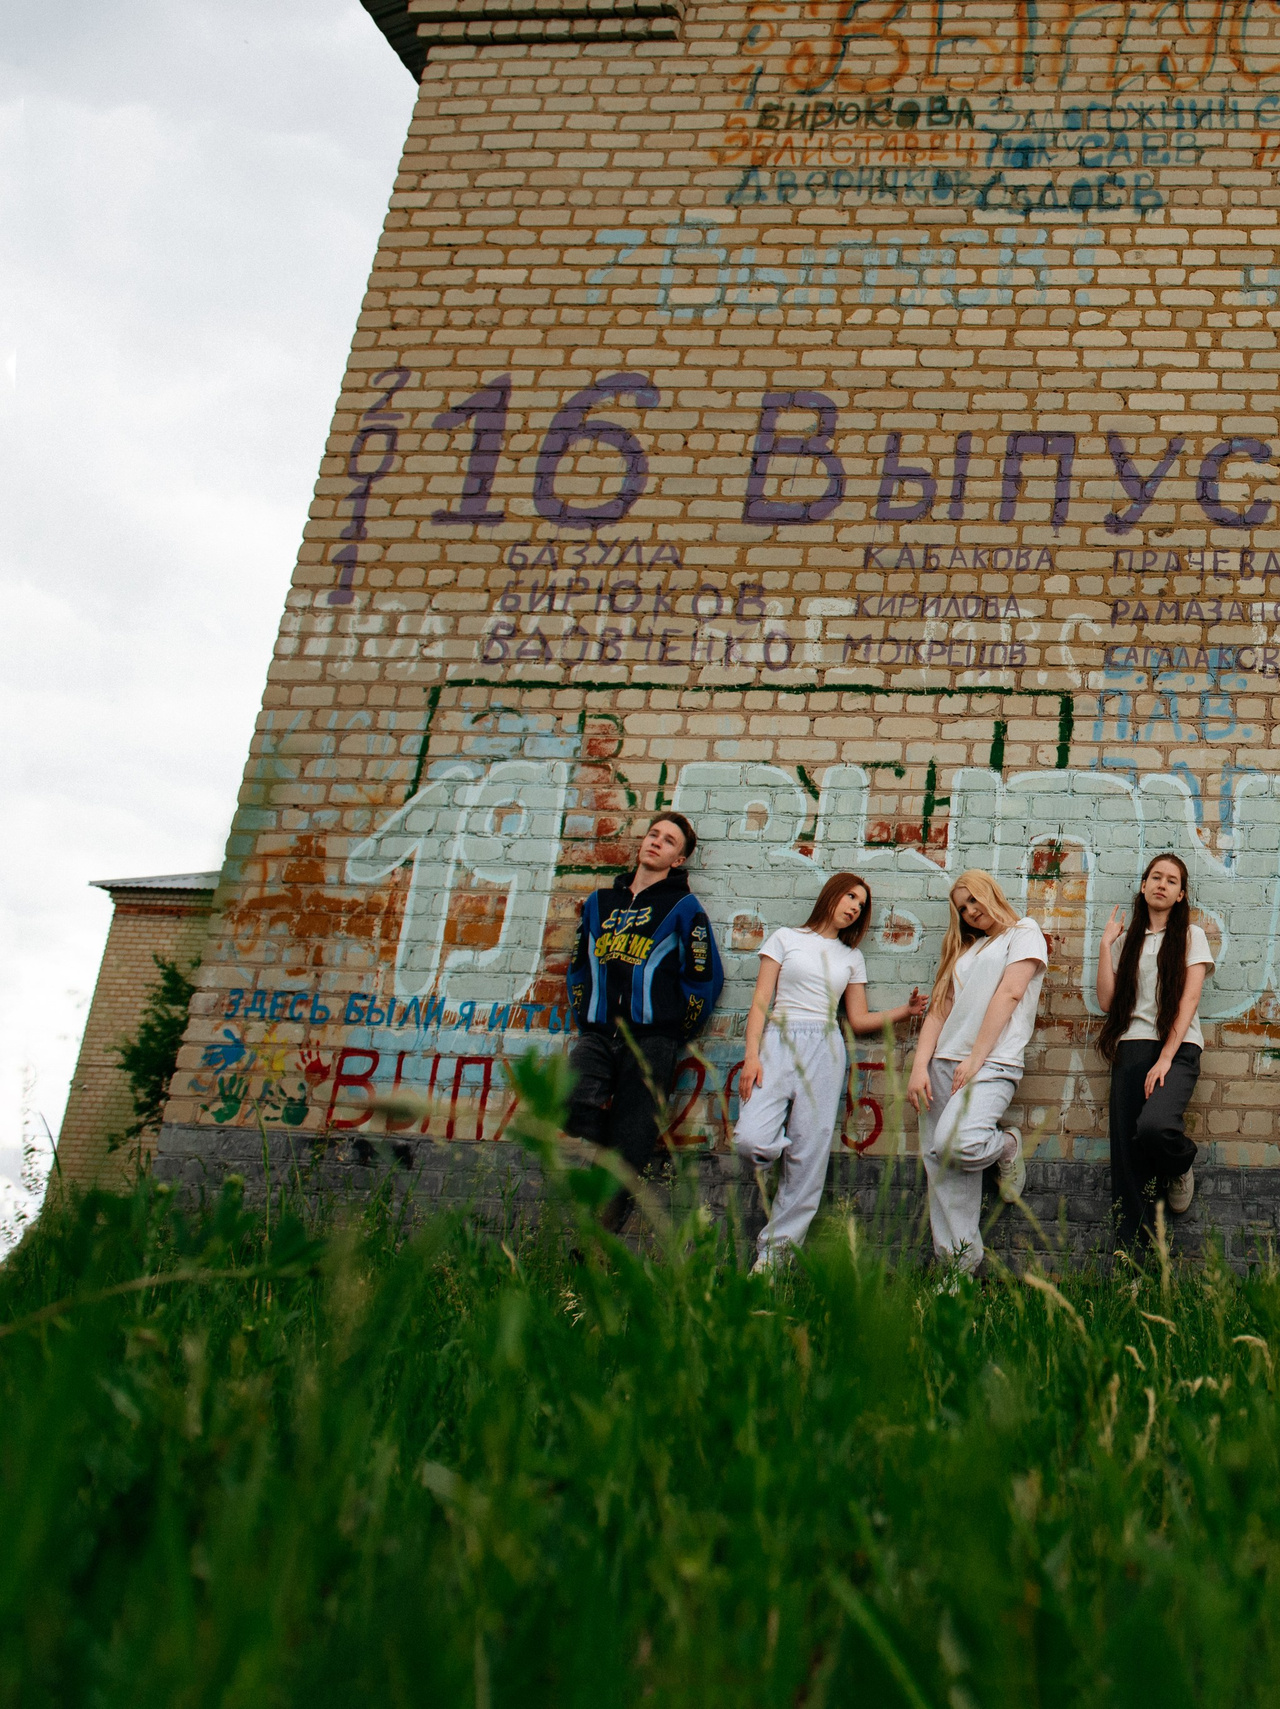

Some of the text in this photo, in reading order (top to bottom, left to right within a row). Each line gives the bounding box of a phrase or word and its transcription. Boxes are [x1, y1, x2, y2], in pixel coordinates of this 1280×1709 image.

[756, 94, 975, 138] БИРЮКОВА
[430, 371, 662, 530] 16
[325, 366, 412, 606] 2011
[504, 538, 684, 573] БАЗУЛА
[862, 544, 1054, 572] КАБАКОВА
[499, 576, 770, 628] БИРЮКОВ
[854, 591, 1021, 621] КИРИЛОВА
[841, 632, 1028, 676] МОКРЕЦОВ
[343, 763, 568, 1000] 19
[224, 988, 574, 1037] ЗДЕСЬ БЫЛИ Я И ТЫ
[650, 1055, 888, 1152] 205
